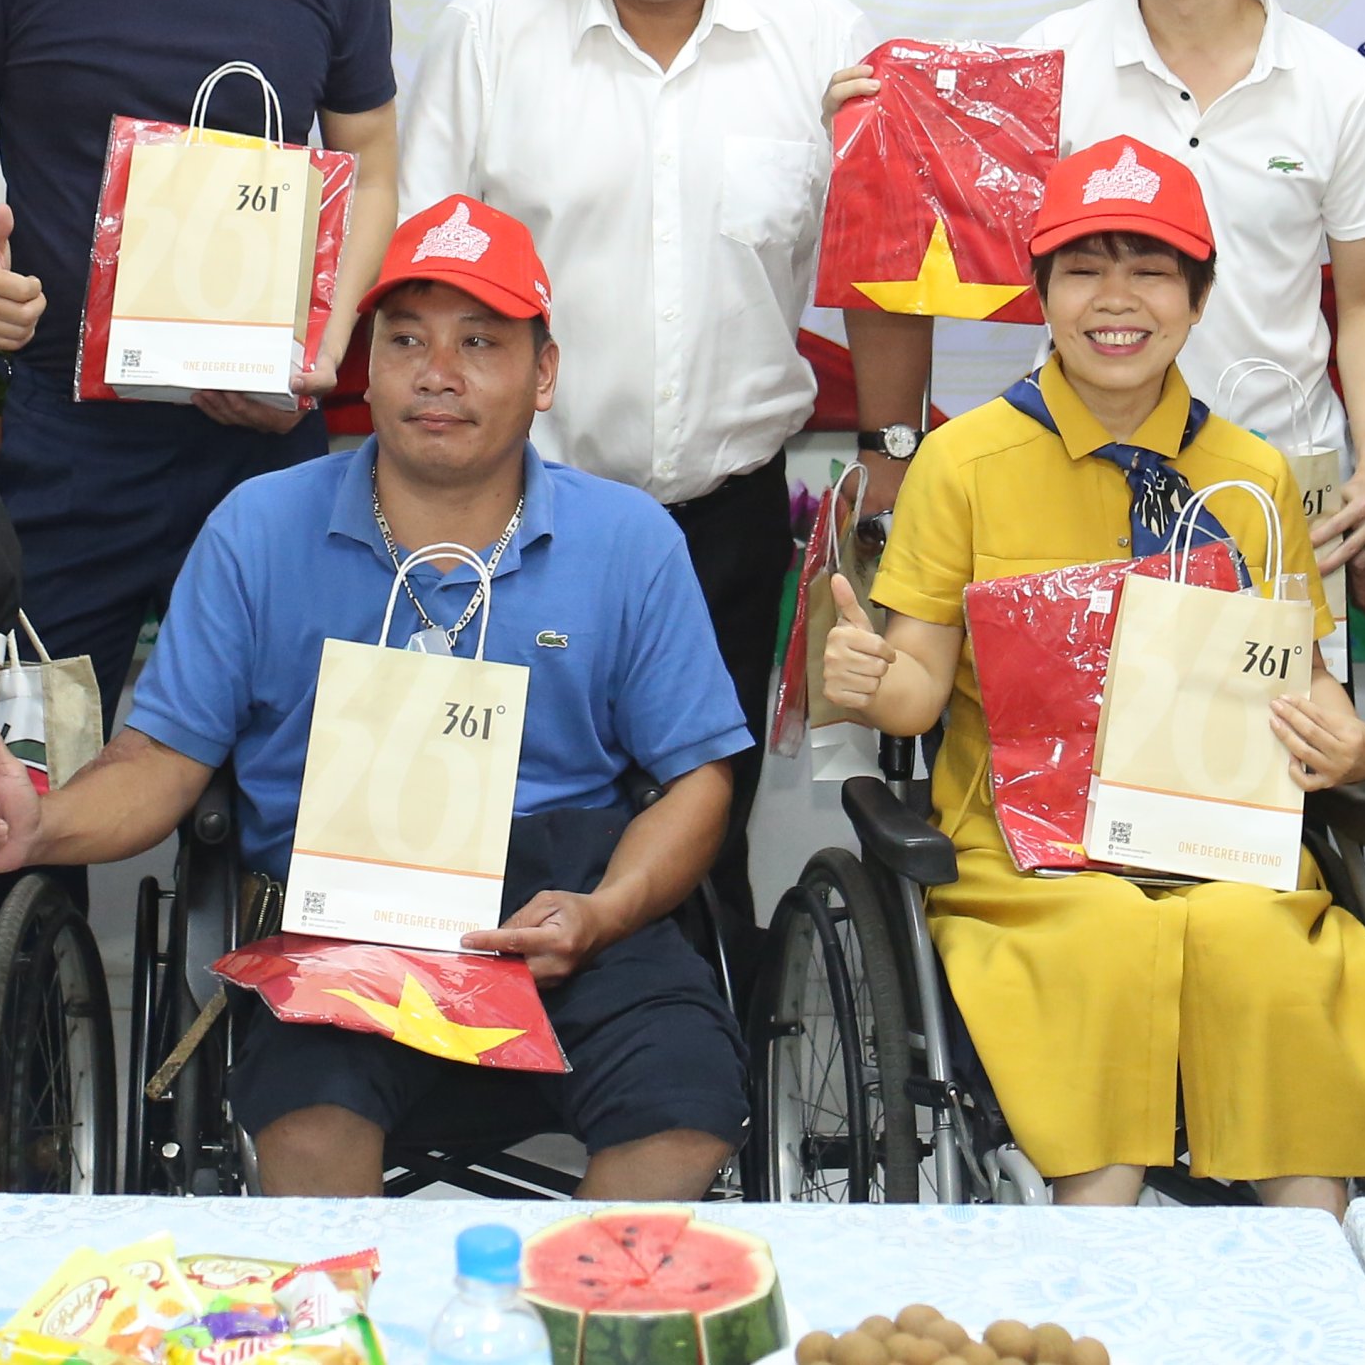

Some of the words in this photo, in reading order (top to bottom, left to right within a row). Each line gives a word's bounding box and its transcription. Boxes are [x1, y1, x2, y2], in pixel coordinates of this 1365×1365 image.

[236, 183, 291, 212] 361°
[183, 361, 201, 372] ONE
[202, 361, 237, 373] DEGREE
[239, 362, 275, 374] BEYOND
[1303, 484, 1332, 516] 61°
[1242, 641, 1302, 679] 361°
[441, 701, 507, 741] 361°
[1178, 840, 1199, 855] ONE
[1200, 844, 1240, 861] DEGREE
[1242, 849, 1282, 868] BEYOND
[374, 909, 395, 925] ONE
[396, 912, 438, 929] DEGREE
[438, 914, 481, 932] BEYOND
